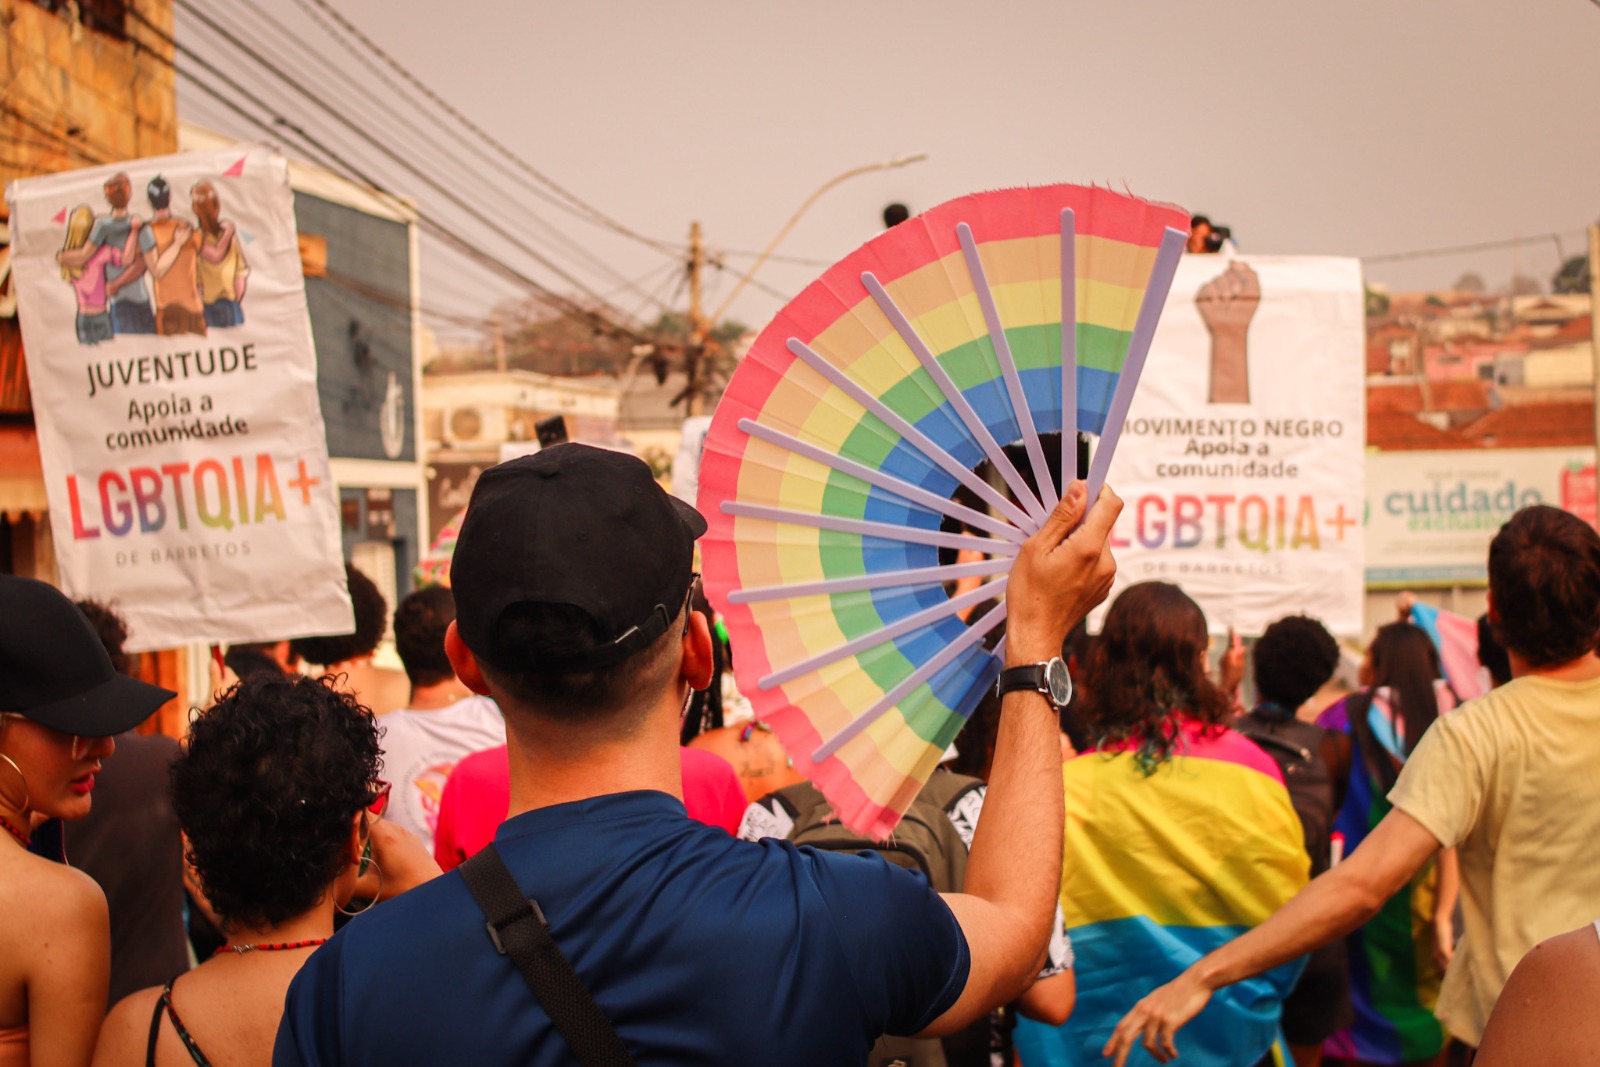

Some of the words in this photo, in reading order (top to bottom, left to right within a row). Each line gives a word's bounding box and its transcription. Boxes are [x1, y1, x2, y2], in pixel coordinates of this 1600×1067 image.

[87, 344, 258, 397] JUVENTUDE
[128, 393, 193, 424] Apoia
[200, 395, 213, 413] a
[106, 416, 249, 450] comunidade
[1264, 419, 1344, 438] NEGRO
[1185, 437, 1249, 459] Apoia
[1257, 442, 1270, 456] a
[1156, 456, 1299, 478] comunidade
[66, 453, 321, 541] LGBTQIA+
[1385, 480, 1543, 515] cuidado
[115, 551, 139, 567] DE
[151, 540, 252, 563] BARRETOS
